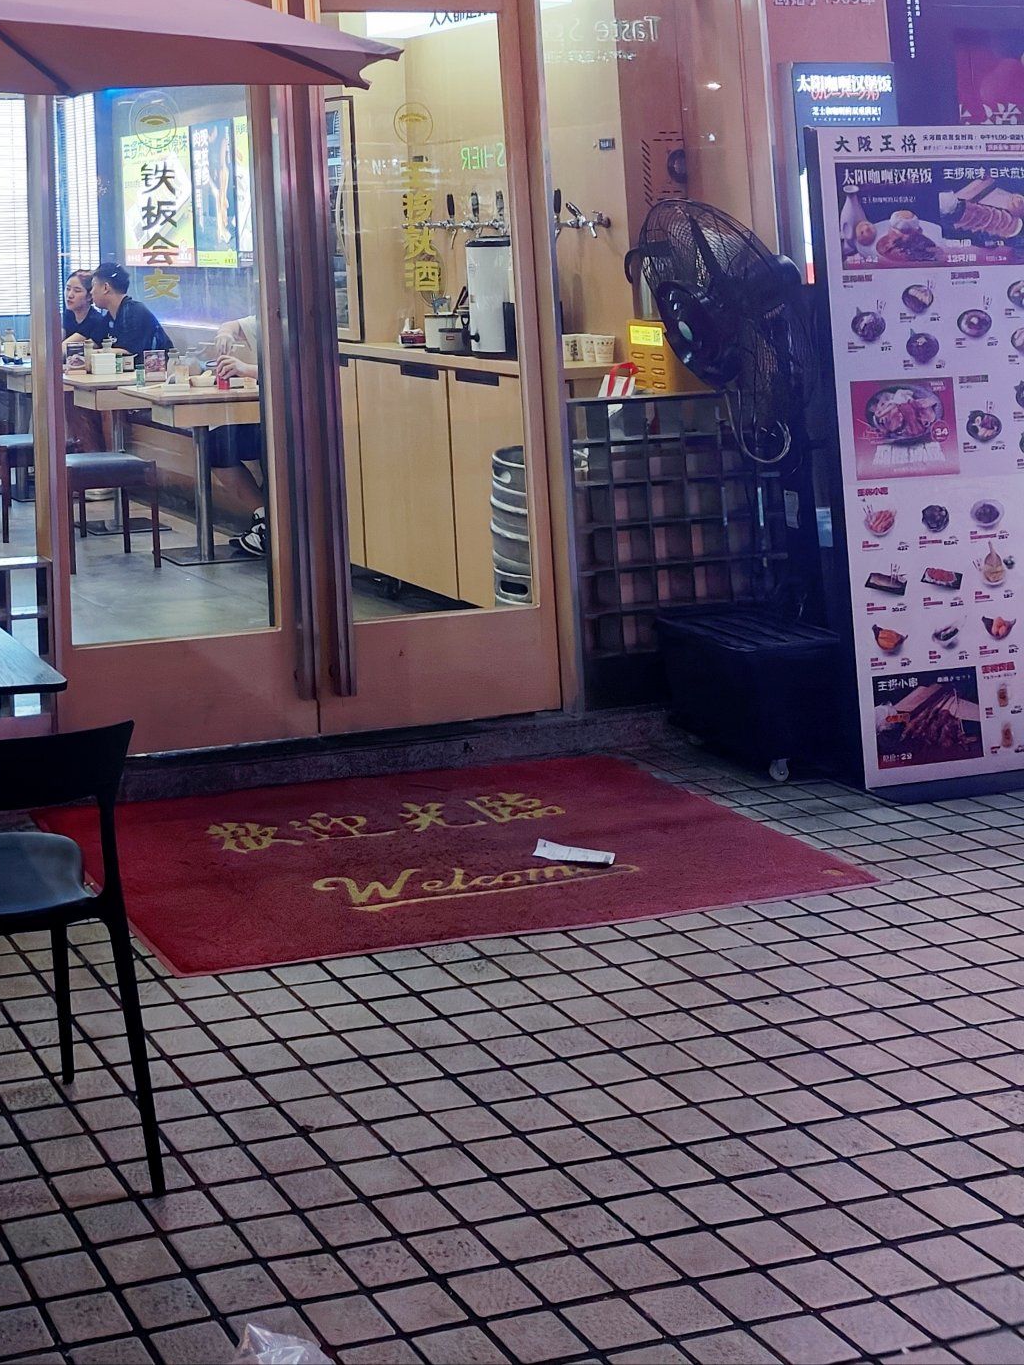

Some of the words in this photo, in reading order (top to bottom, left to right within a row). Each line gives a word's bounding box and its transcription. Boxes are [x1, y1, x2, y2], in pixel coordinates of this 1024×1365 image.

[834, 134, 918, 153] 大阪王将
[140, 160, 180, 302] 铁板会友
[313, 865, 626, 907] Welcom
